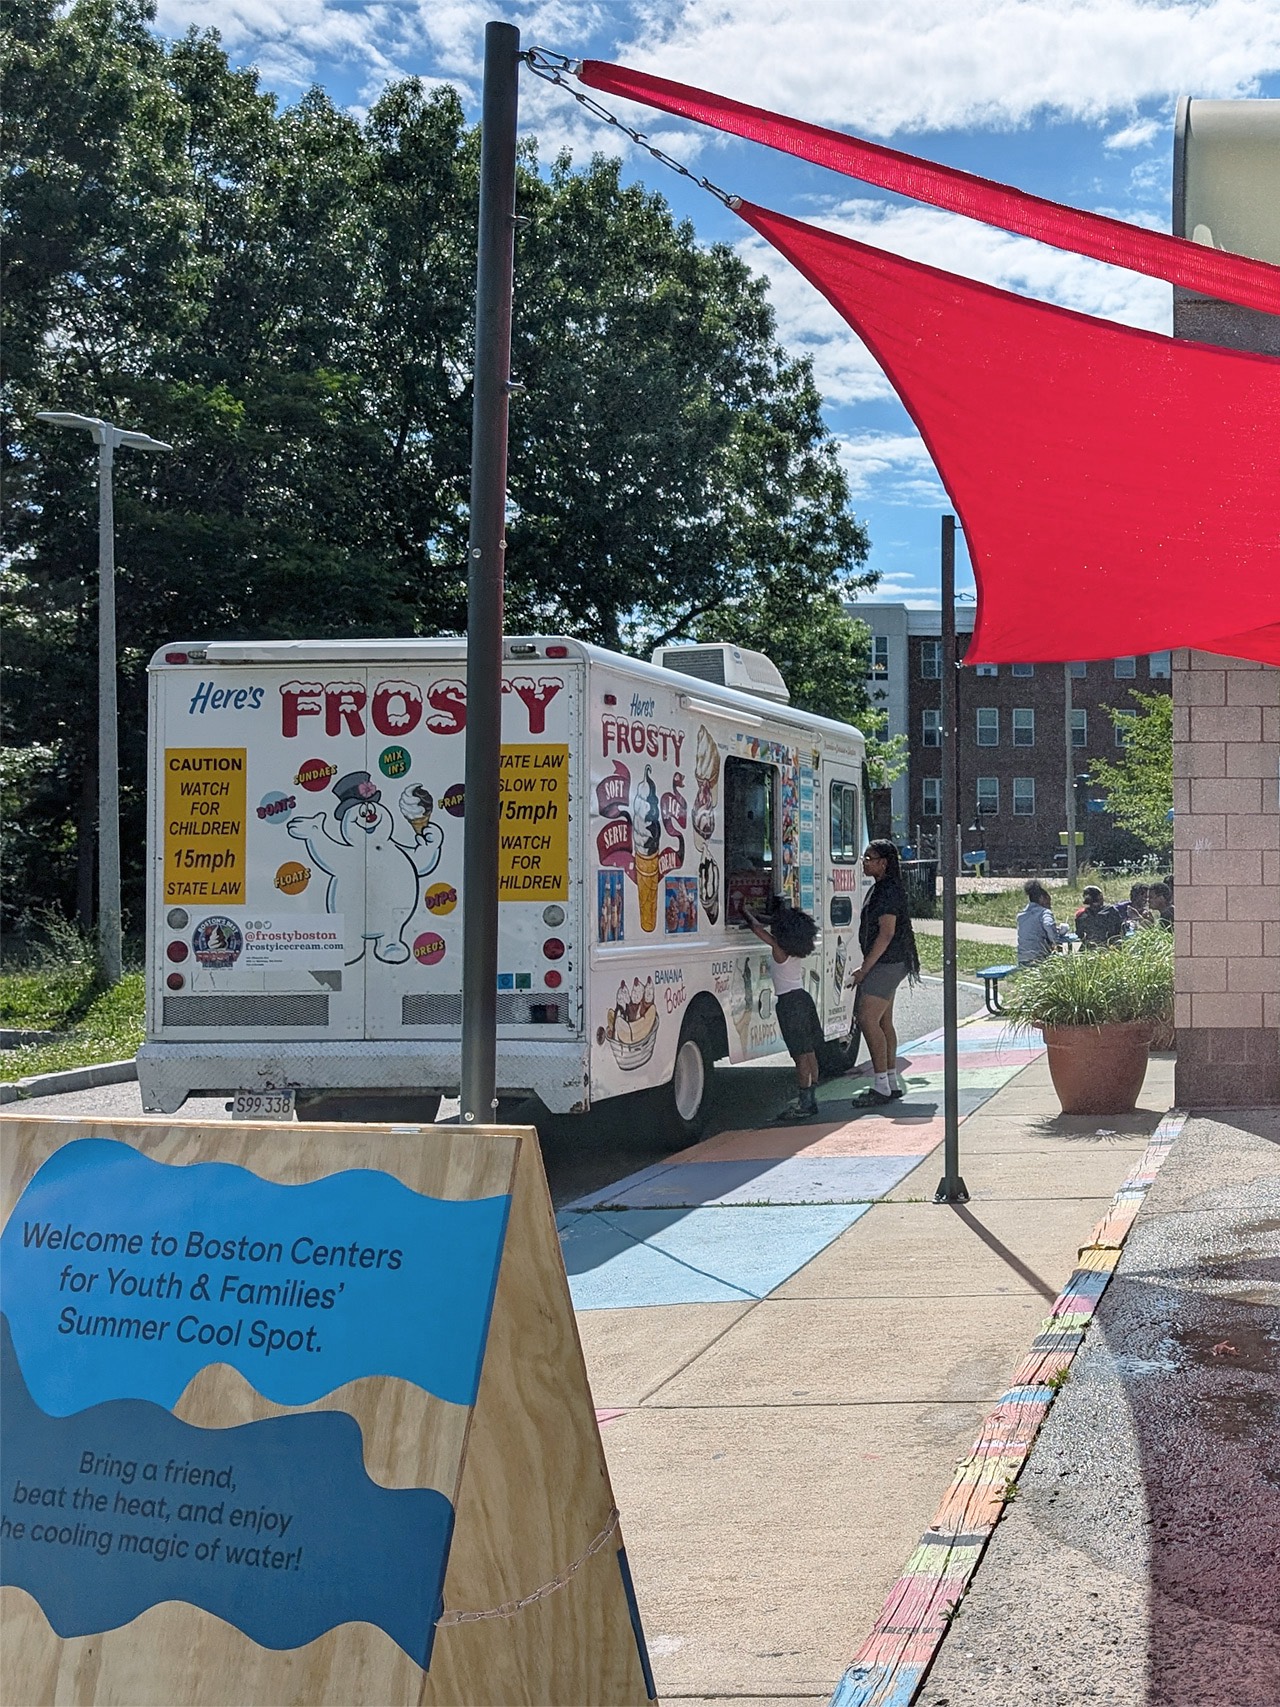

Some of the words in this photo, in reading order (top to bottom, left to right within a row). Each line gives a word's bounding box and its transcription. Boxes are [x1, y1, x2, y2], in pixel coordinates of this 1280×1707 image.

[188, 681, 265, 715] Here's
[279, 677, 565, 738] FROSY
[630, 693, 655, 718] Here's
[601, 713, 686, 768] FROSTY
[169, 758, 242, 771] CAUTION
[384, 750, 403, 764] MIX
[499, 755, 531, 768] TATE
[534, 755, 564, 768] LAW
[293, 764, 338, 786] SUNDAES
[499, 778, 537, 792] SLOW
[541, 778, 558, 792] TO
[180, 782, 230, 796] WATCH
[605, 780, 625, 800] SOFT
[190, 802, 220, 816] FOR
[256, 795, 297, 819] BOATS
[438, 793, 465, 809] FRAP
[668, 796, 681, 819] ICE
[499, 801, 558, 825] 15mph
[169, 821, 241, 836] CHILDREN
[603, 824, 628, 849] SERVE
[501, 836, 551, 850] WATCH
[174, 849, 236, 873] 15mph
[511, 856, 542, 870] FOR
[658, 852, 677, 875] CREAM
[167, 882, 208, 896] STATE
[211, 881, 241, 895] LAW
[274, 867, 312, 889] FLOATS
[499, 875, 562, 889] HILDREN
[425, 888, 457, 910] DIPS
[245, 930, 337, 942] @frostyboston
[246, 942, 344, 952] frostyicecream.com
[655, 968, 684, 985] BANANA
[711, 961, 733, 976] DOUBLE
[664, 983, 687, 1014] Boat
[23, 1221, 143, 1254] Welcome
[151, 1230, 178, 1256] to
[185, 1231, 283, 1263] Boston
[290, 1236, 403, 1270] Centers
[59, 1264, 99, 1293] for
[107, 1267, 183, 1299] Youth
[189, 1273, 211, 1302] &
[58, 1306, 170, 1341] Summer
[176, 1314, 243, 1347] Cool
[248, 1319, 322, 1356] Spot.
[79, 1451, 138, 1485] Bring
[142, 1463, 158, 1482] a
[164, 1458, 237, 1493] friend,
[12, 1480, 67, 1508] beat
[73, 1486, 108, 1512] the
[113, 1491, 171, 1523] heat,
[177, 1501, 225, 1525] and
[229, 1505, 294, 1538] enjoy
[0, 1514, 26, 1540] he
[30, 1522, 113, 1555] cooling
[118, 1533, 190, 1562] magic
[194, 1537, 221, 1562] of
[225, 1545, 303, 1571] water!
